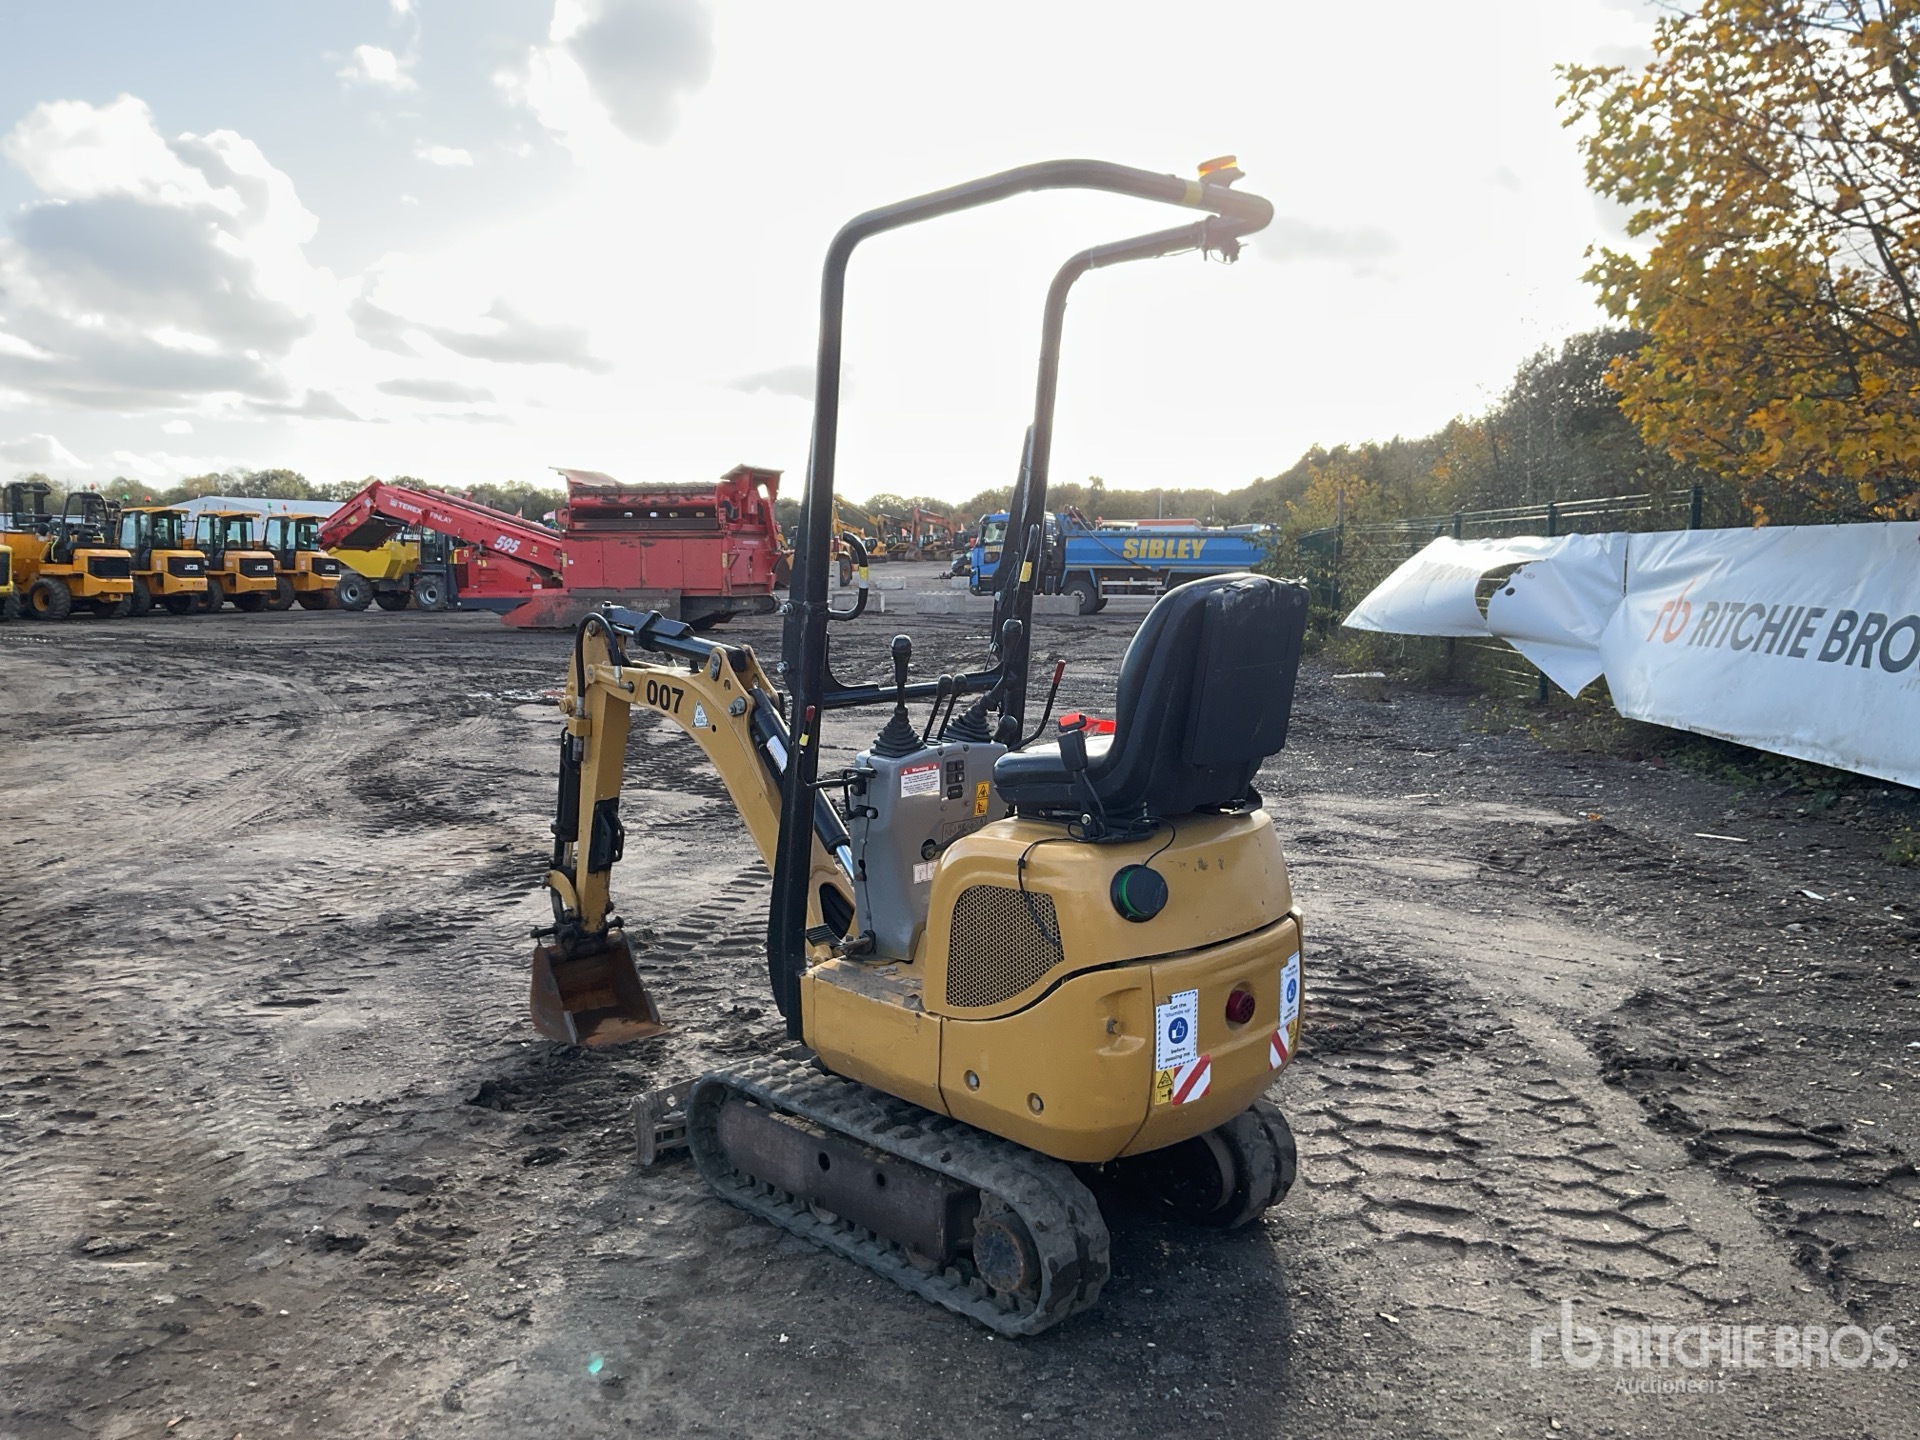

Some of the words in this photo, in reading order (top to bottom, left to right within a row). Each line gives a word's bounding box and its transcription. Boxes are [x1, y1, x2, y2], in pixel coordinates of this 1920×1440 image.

[398, 501, 422, 514] TEREX
[429, 511, 452, 524] FINLAY
[493, 535, 521, 554] 595
[1123, 538, 1206, 559] SIBLEY
[184, 563, 199, 571] JCB
[1687, 600, 1828, 659] RITCHIE
[1817, 609, 1920, 673] BRO
[646, 680, 684, 713] 007
